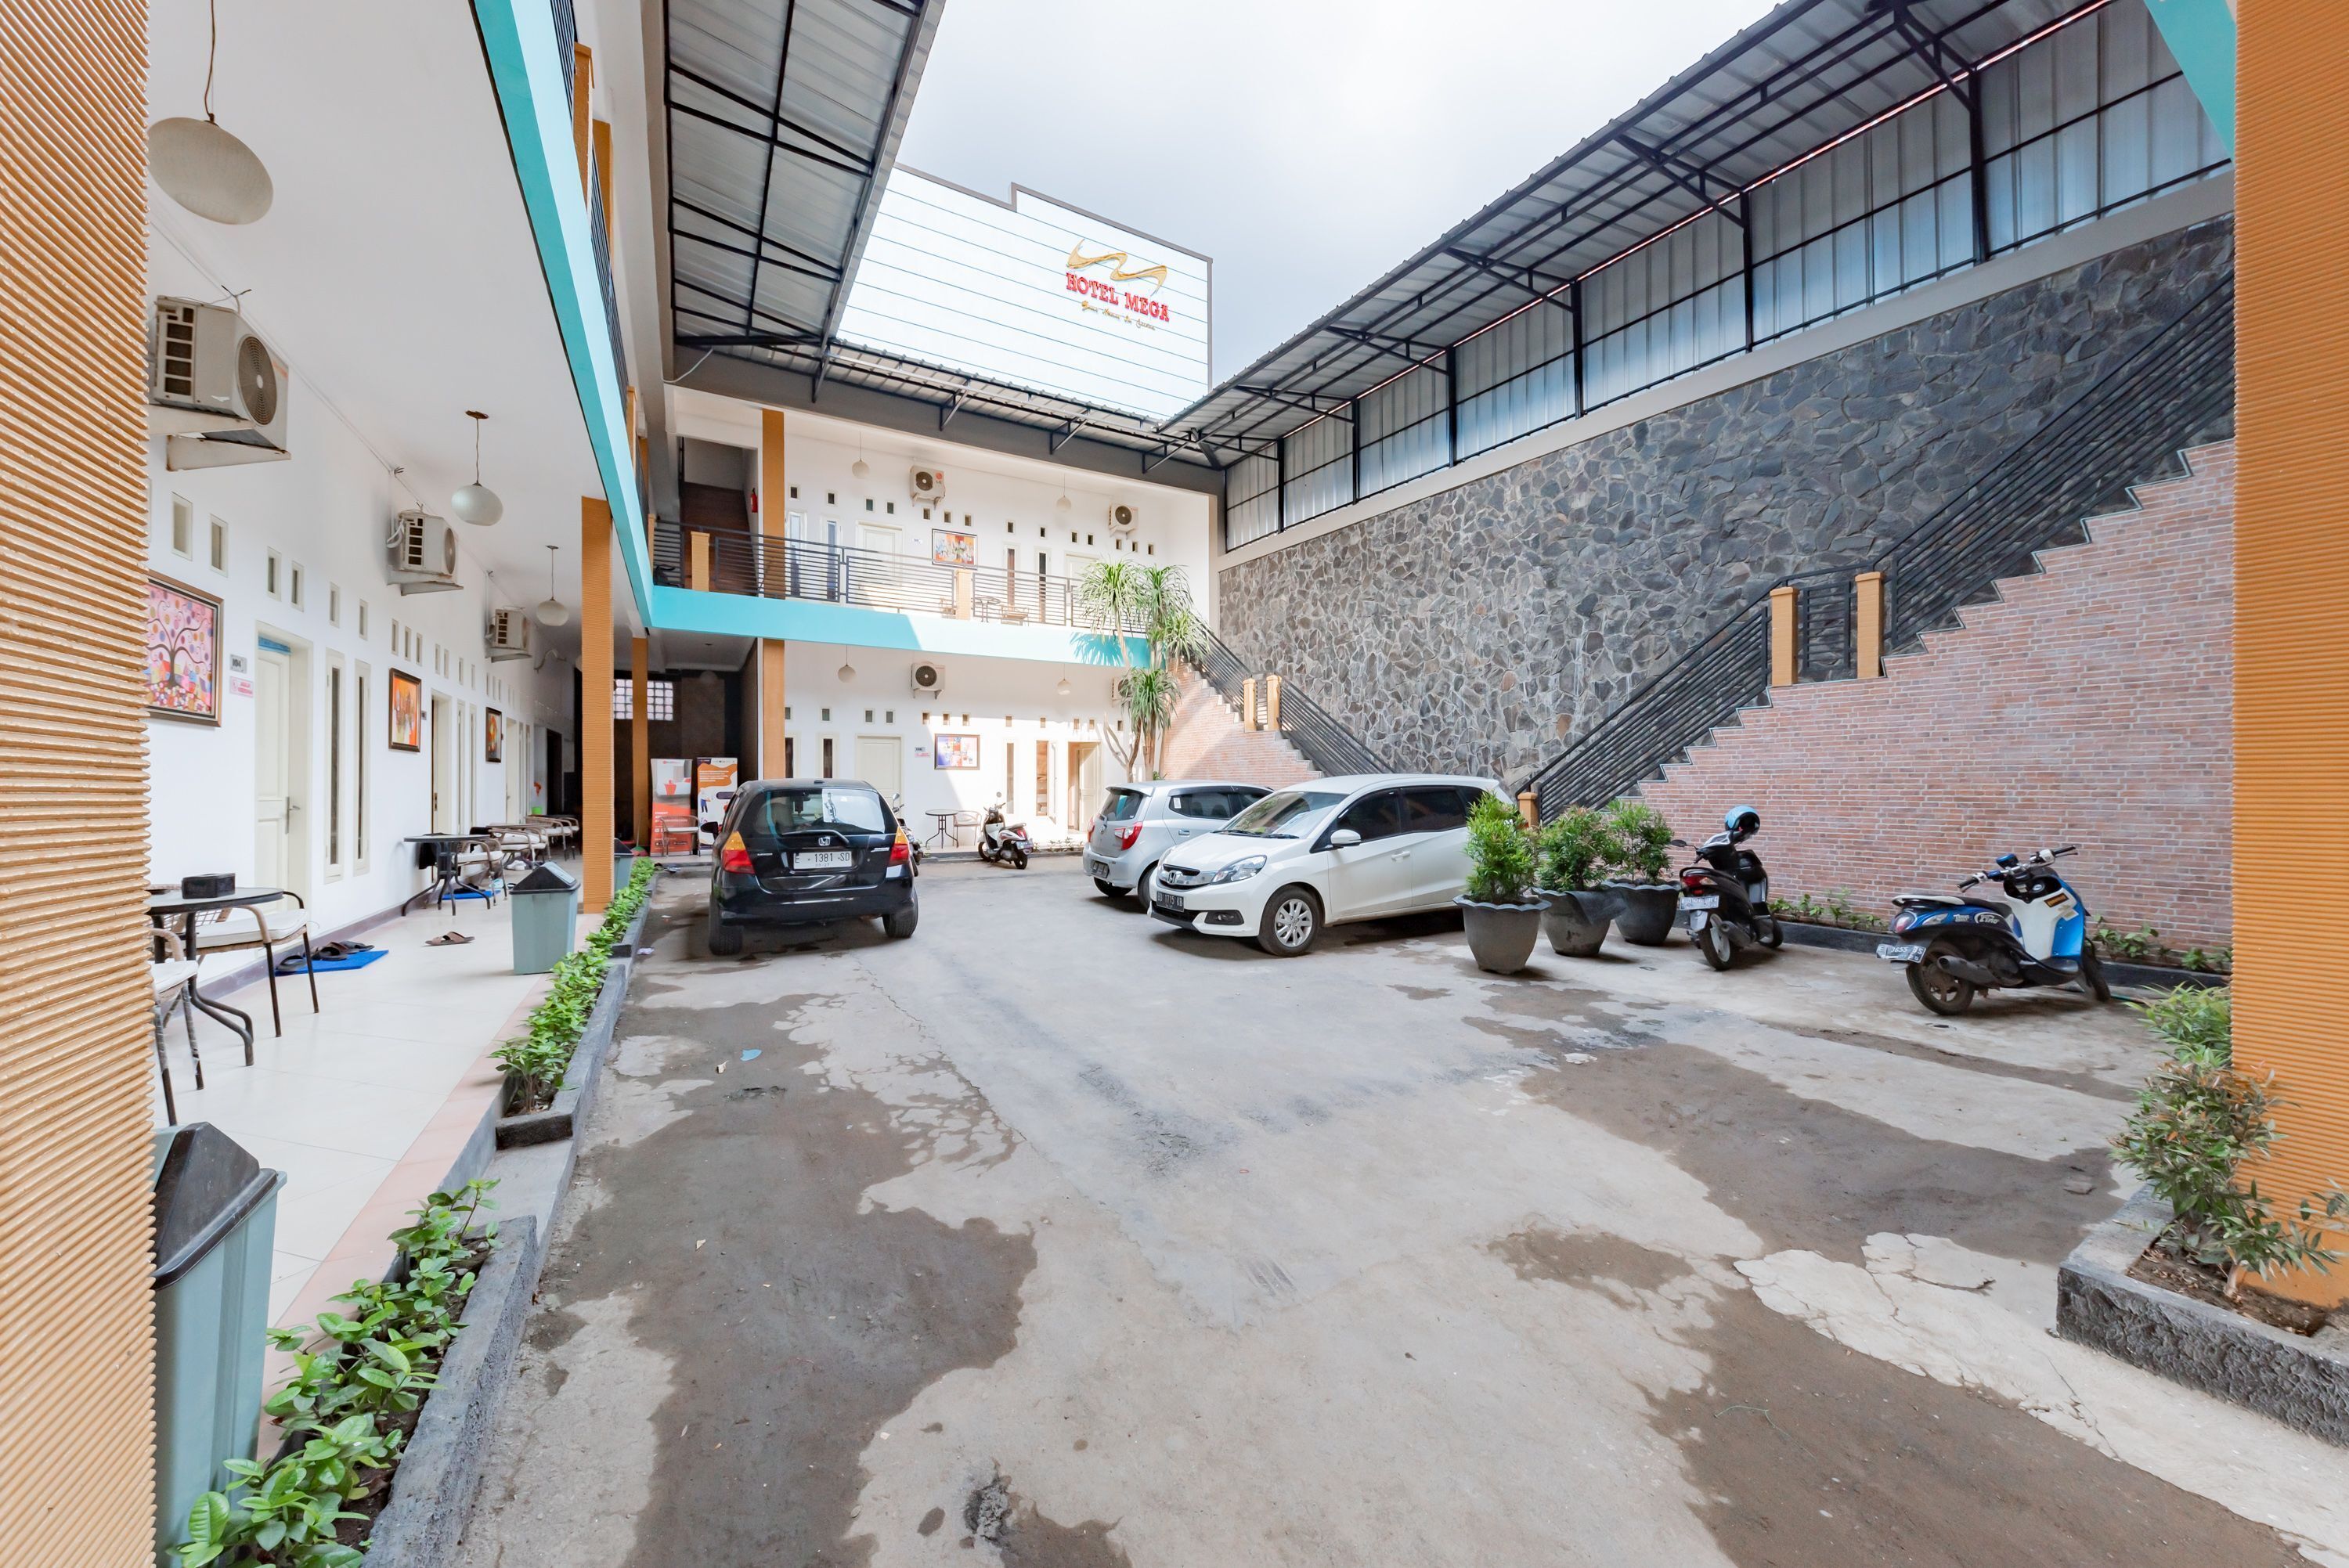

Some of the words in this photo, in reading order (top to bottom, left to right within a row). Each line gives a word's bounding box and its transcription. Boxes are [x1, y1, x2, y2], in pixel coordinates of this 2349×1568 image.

[1066, 272, 1119, 305] HOTEL
[1124, 292, 1170, 323] MEGA
[814, 852, 834, 863] 1381
[839, 852, 850, 862] SD
